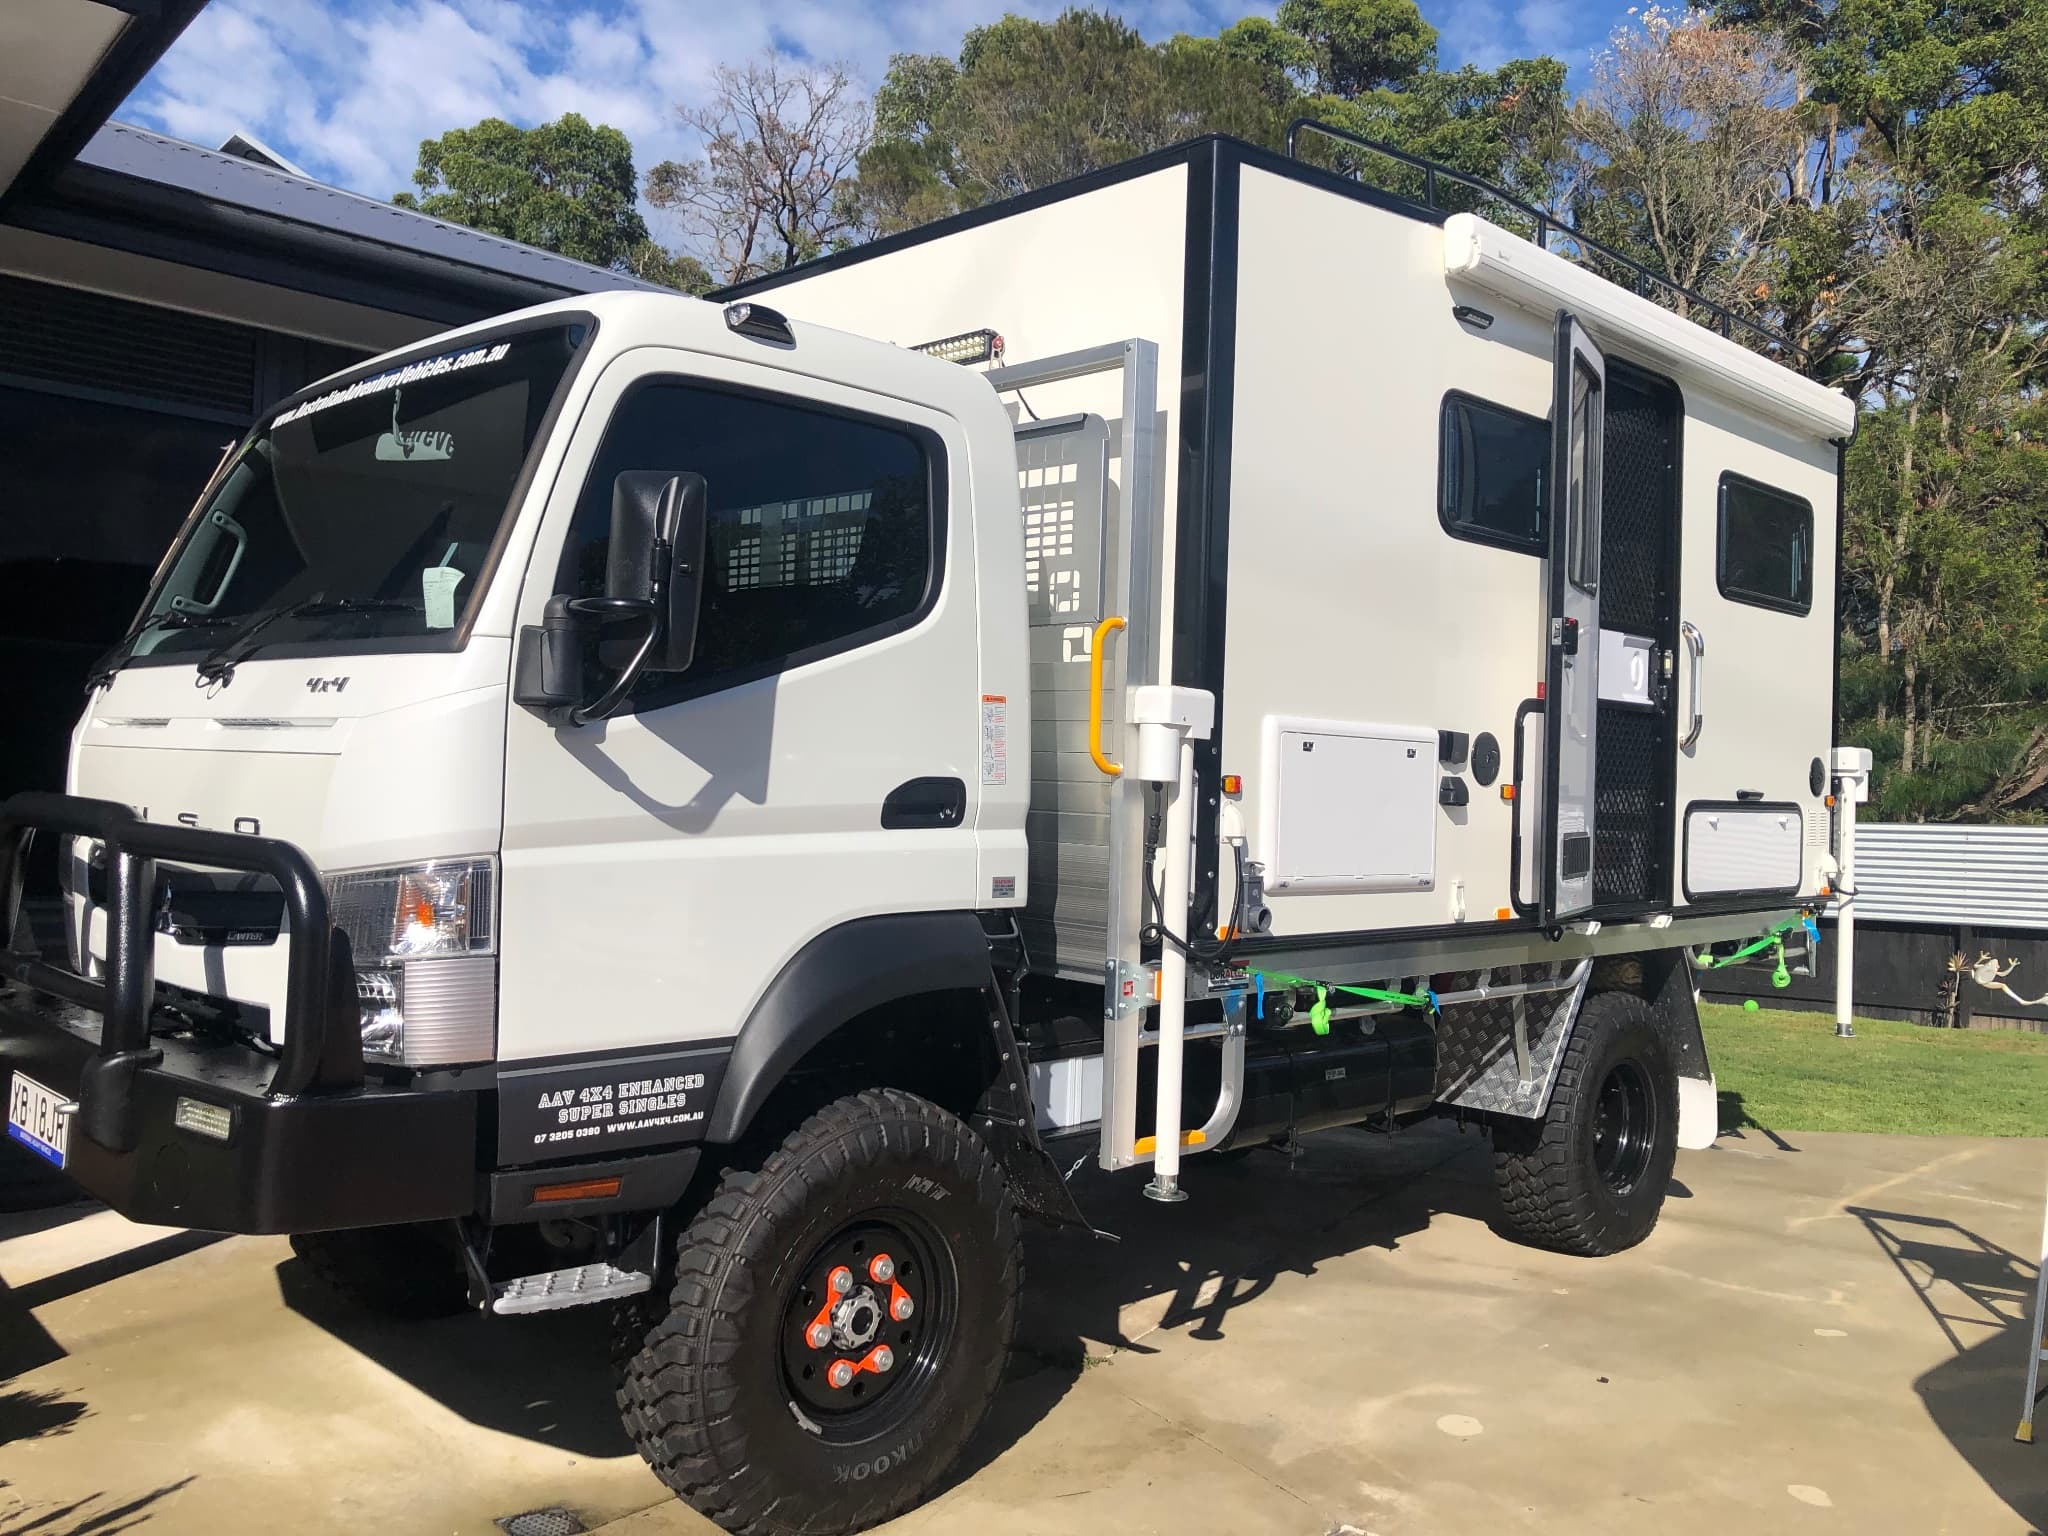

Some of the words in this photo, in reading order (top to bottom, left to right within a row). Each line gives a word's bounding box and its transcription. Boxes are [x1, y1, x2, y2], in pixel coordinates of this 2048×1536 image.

[538, 1090, 575, 1108] AAV
[580, 1085, 613, 1103] 4X4
[618, 1074, 704, 1098] ENHANCED
[558, 1103, 614, 1124] SUPER
[618, 1093, 686, 1116] SINGLES
[534, 1134, 547, 1144] 07
[549, 1130, 574, 1142] 3205
[575, 1126, 600, 1138] 0380
[607, 1111, 704, 1133] WWW.AAV4X4.COM.AU
